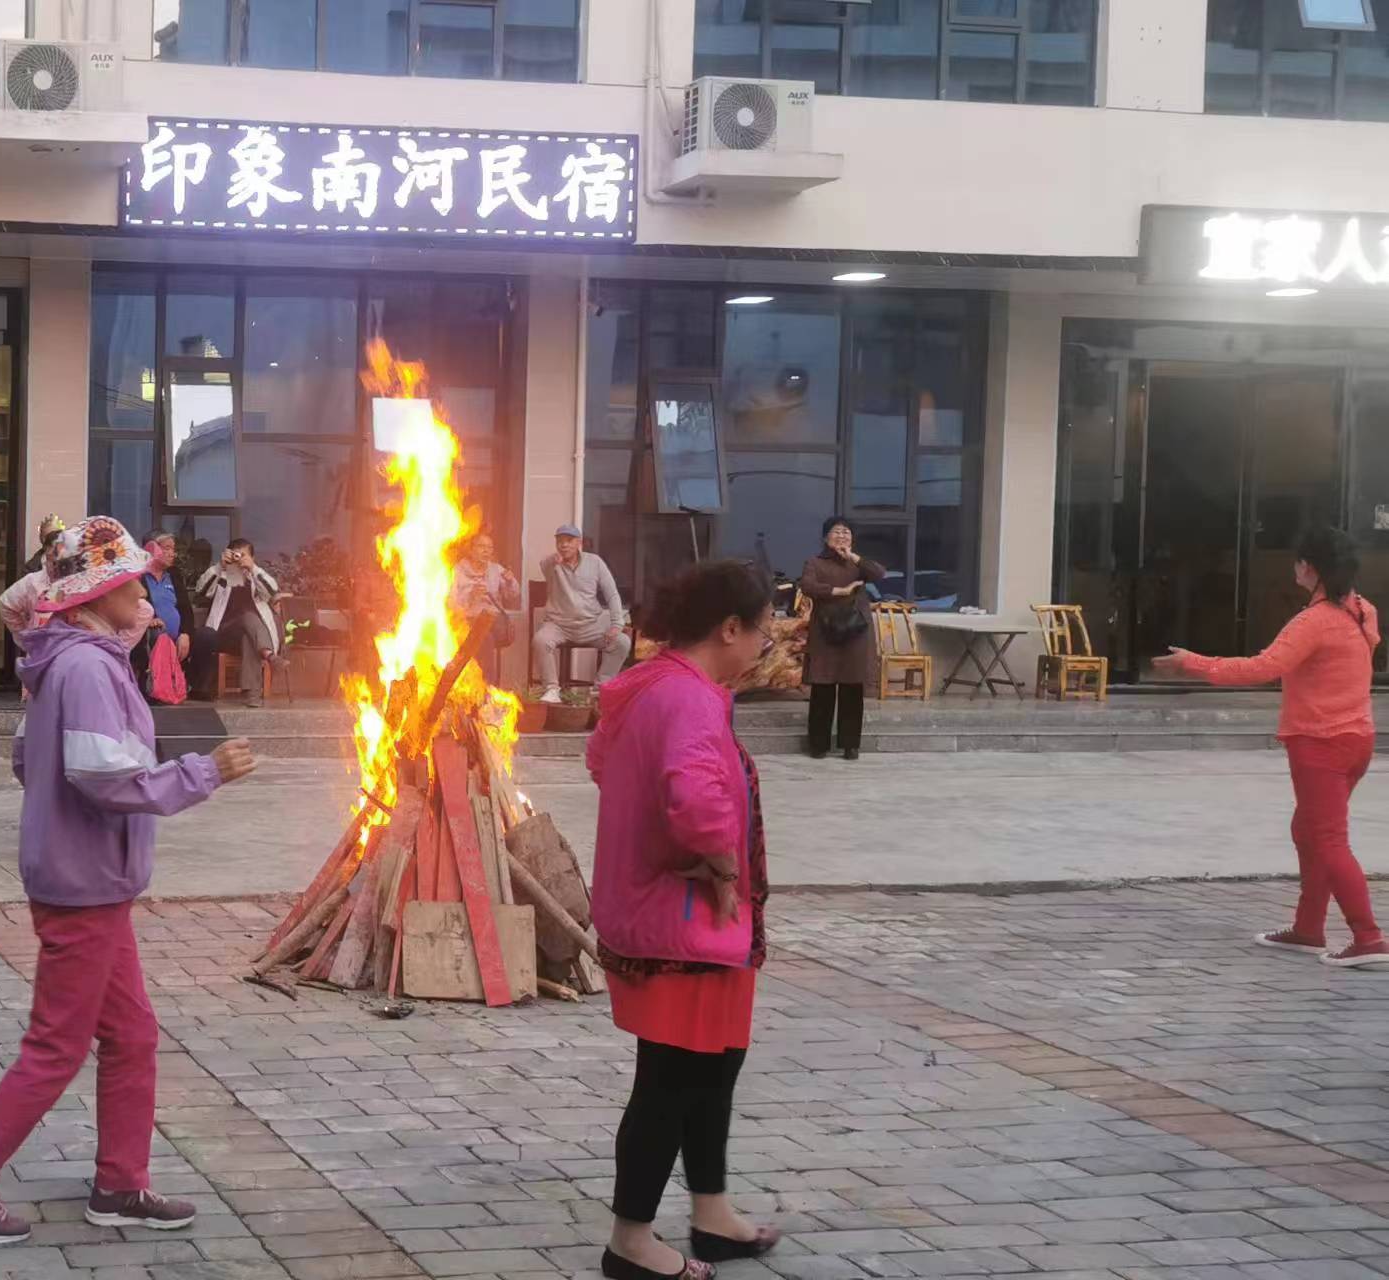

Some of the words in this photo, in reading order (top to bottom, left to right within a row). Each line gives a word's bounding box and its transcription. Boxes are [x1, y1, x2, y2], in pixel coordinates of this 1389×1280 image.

[140, 126, 626, 223] 印象南河民宿
[1198, 212, 1389, 284] 宜家人
